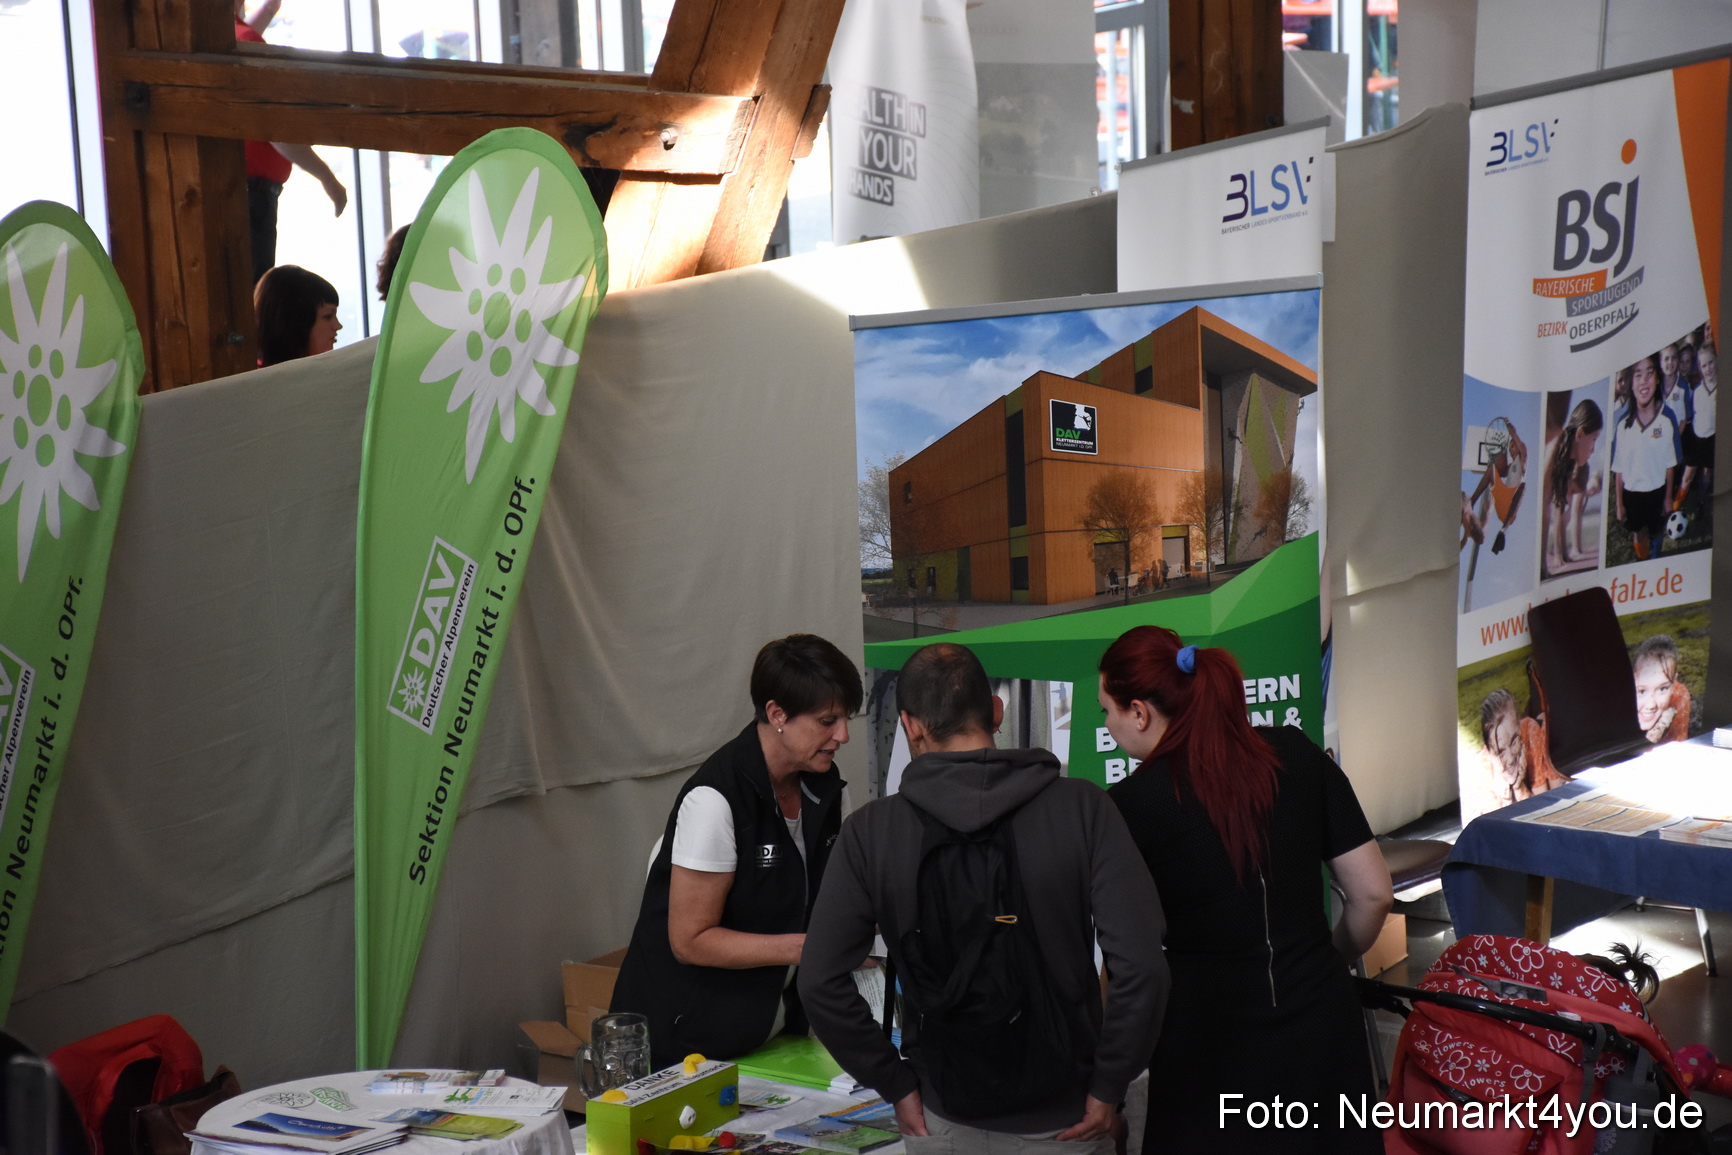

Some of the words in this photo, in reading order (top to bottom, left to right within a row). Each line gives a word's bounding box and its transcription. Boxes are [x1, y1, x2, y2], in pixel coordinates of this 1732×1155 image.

[862, 88, 907, 130] ALTH
[860, 126, 917, 178] YOUR
[848, 168, 893, 203] HANDS
[1535, 277, 1596, 297] BAYERISCHE
[1571, 276, 1640, 316] SPORTJUGEND
[1536, 320, 1569, 339] BEZIRK
[1569, 301, 1636, 340] OBERPFALZ
[1055, 427, 1081, 440] DAV
[504, 475, 536, 537] OPf.
[494, 548, 517, 574] d.
[409, 551, 456, 669] DAV
[485, 584, 507, 601] i.
[422, 652, 449, 728] Deutscher
[445, 563, 475, 651] Alpenverein
[443, 605, 500, 758] Neumarkt
[5, 669, 32, 765] Alpenverein
[5, 715, 57, 881] Neumarkt
[58, 575, 83, 641] OPf.
[409, 765, 455, 886] Sektion
[623, 1069, 680, 1091] DANKE
